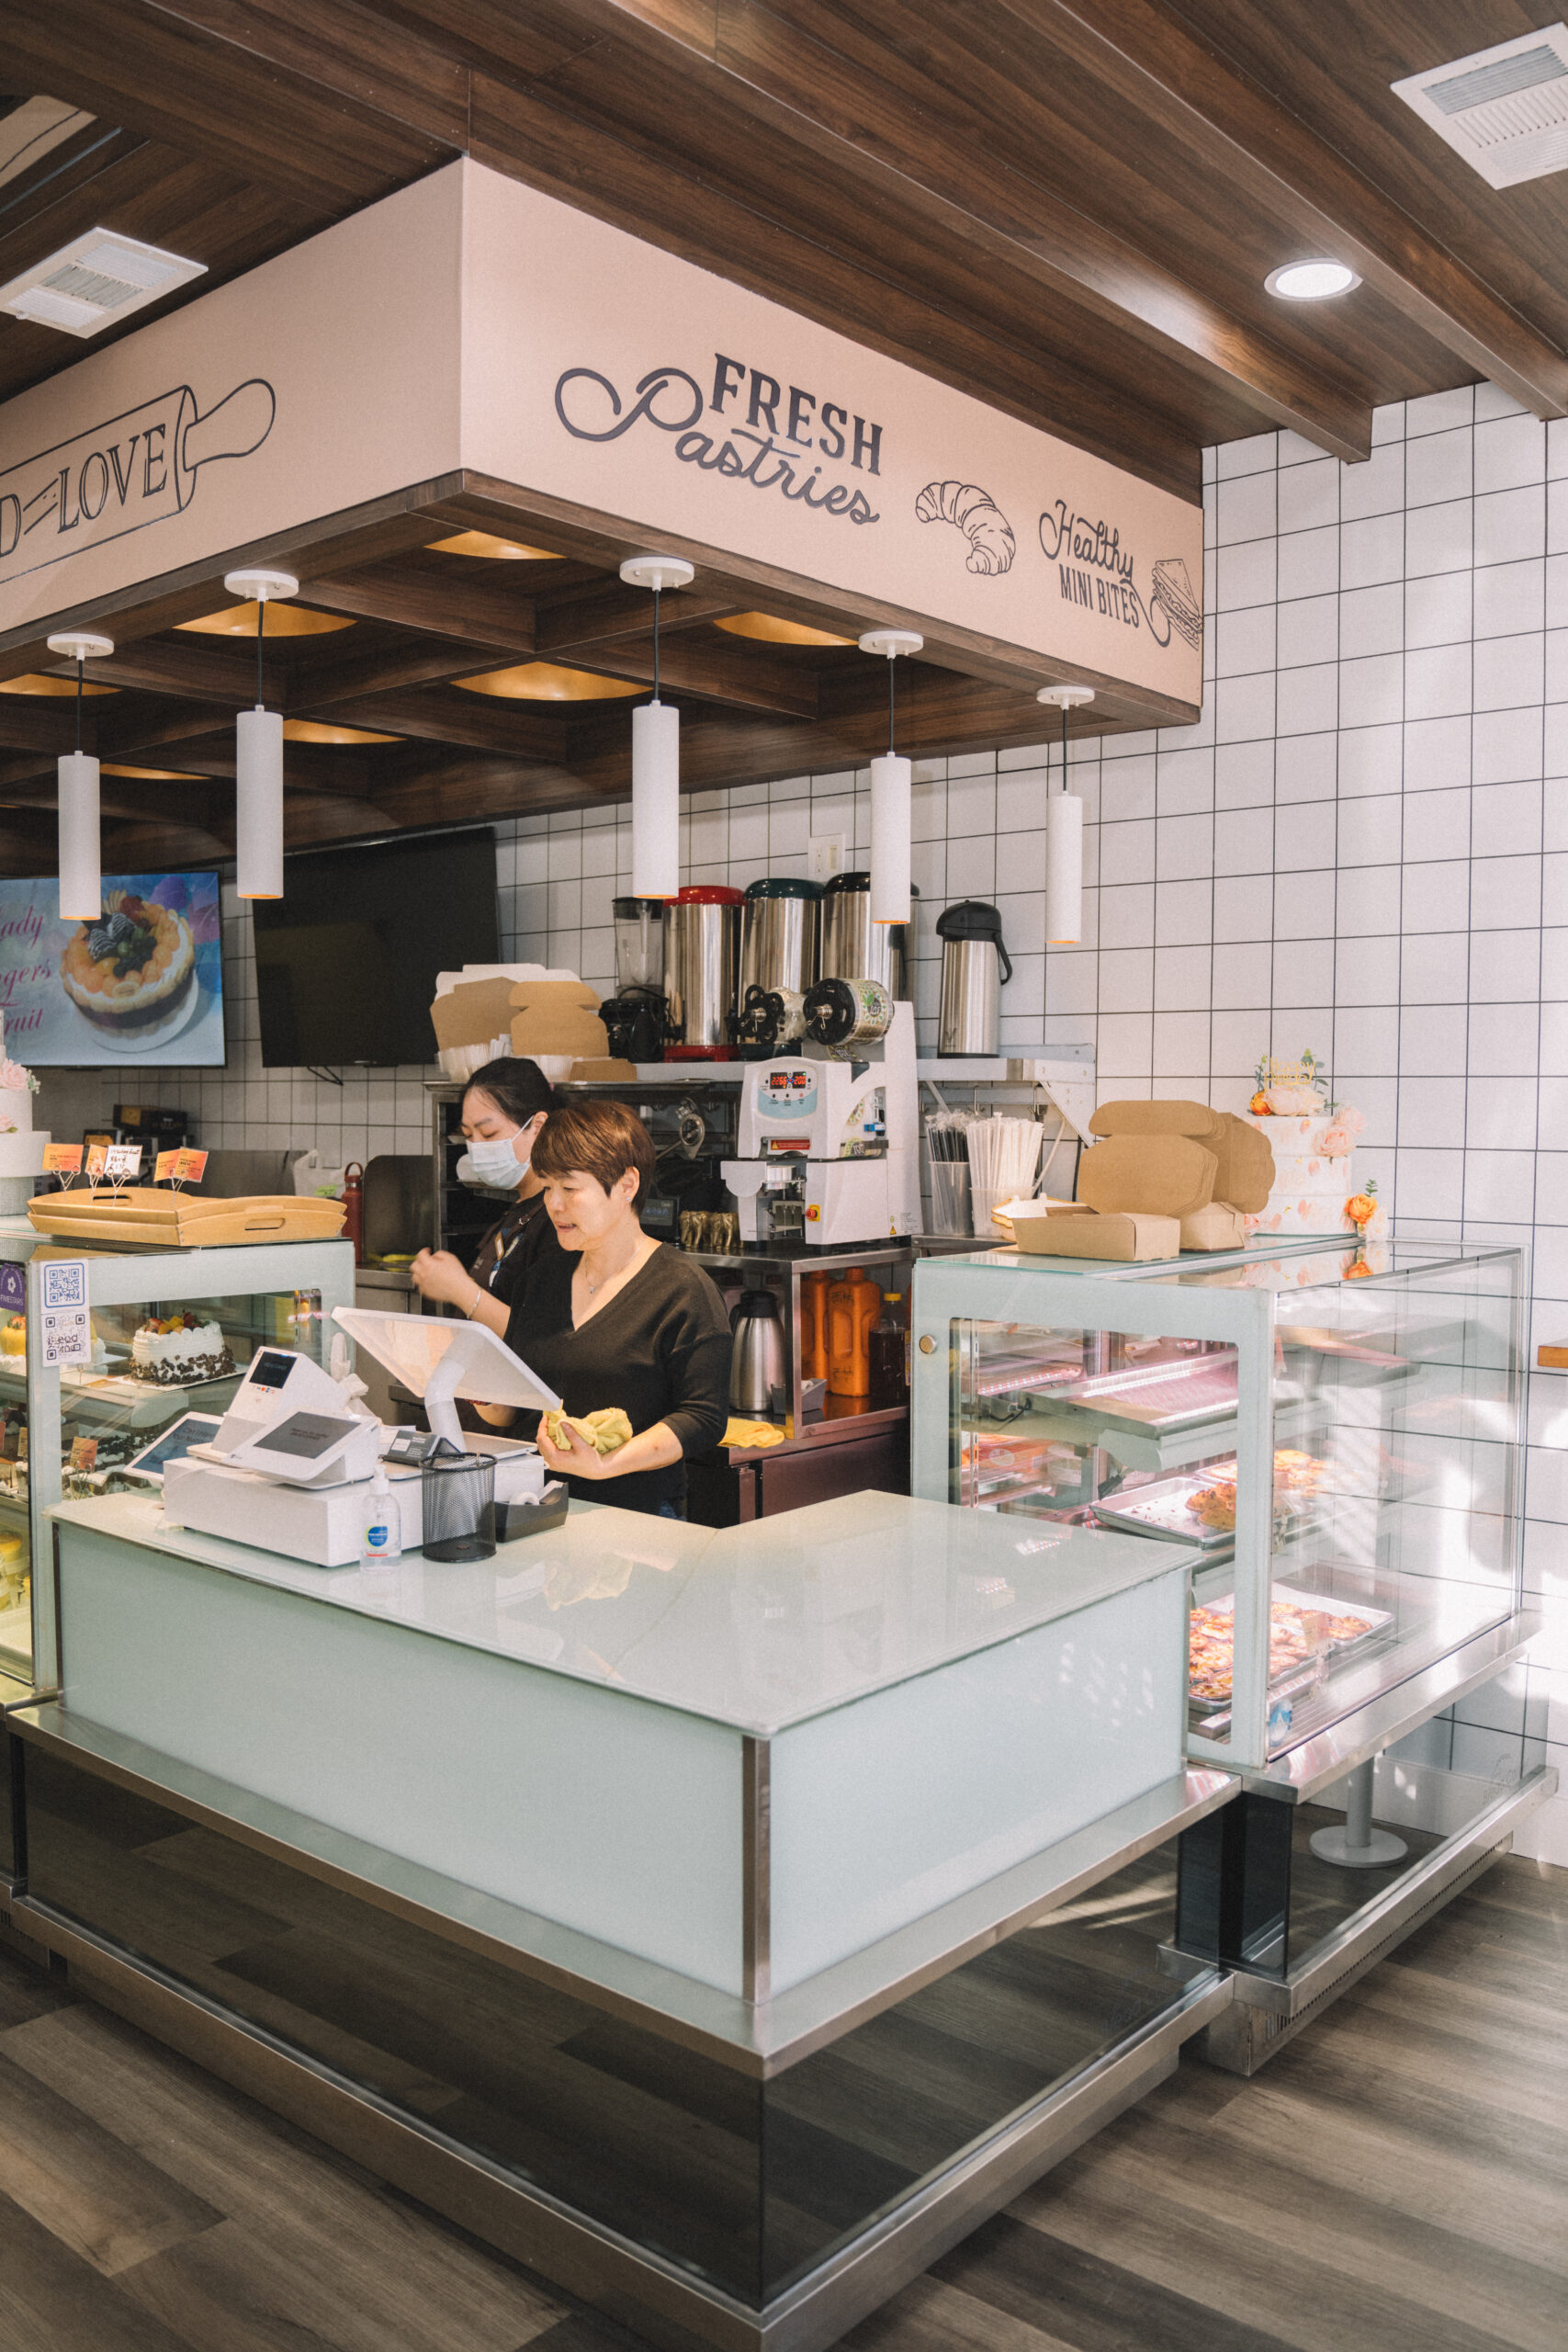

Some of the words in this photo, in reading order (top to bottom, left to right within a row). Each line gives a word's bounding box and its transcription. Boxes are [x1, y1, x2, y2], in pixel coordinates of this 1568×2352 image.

[554, 367, 881, 526] Pastries
[708, 353, 884, 477] FRESH
[57, 423, 167, 534] LOVE
[1059, 563, 1094, 610] MINI
[1096, 577, 1140, 628] BITES
[0, 904, 43, 949] ady
[0, 958, 51, 1002] gers
[2, 1003, 43, 1035] ruit
